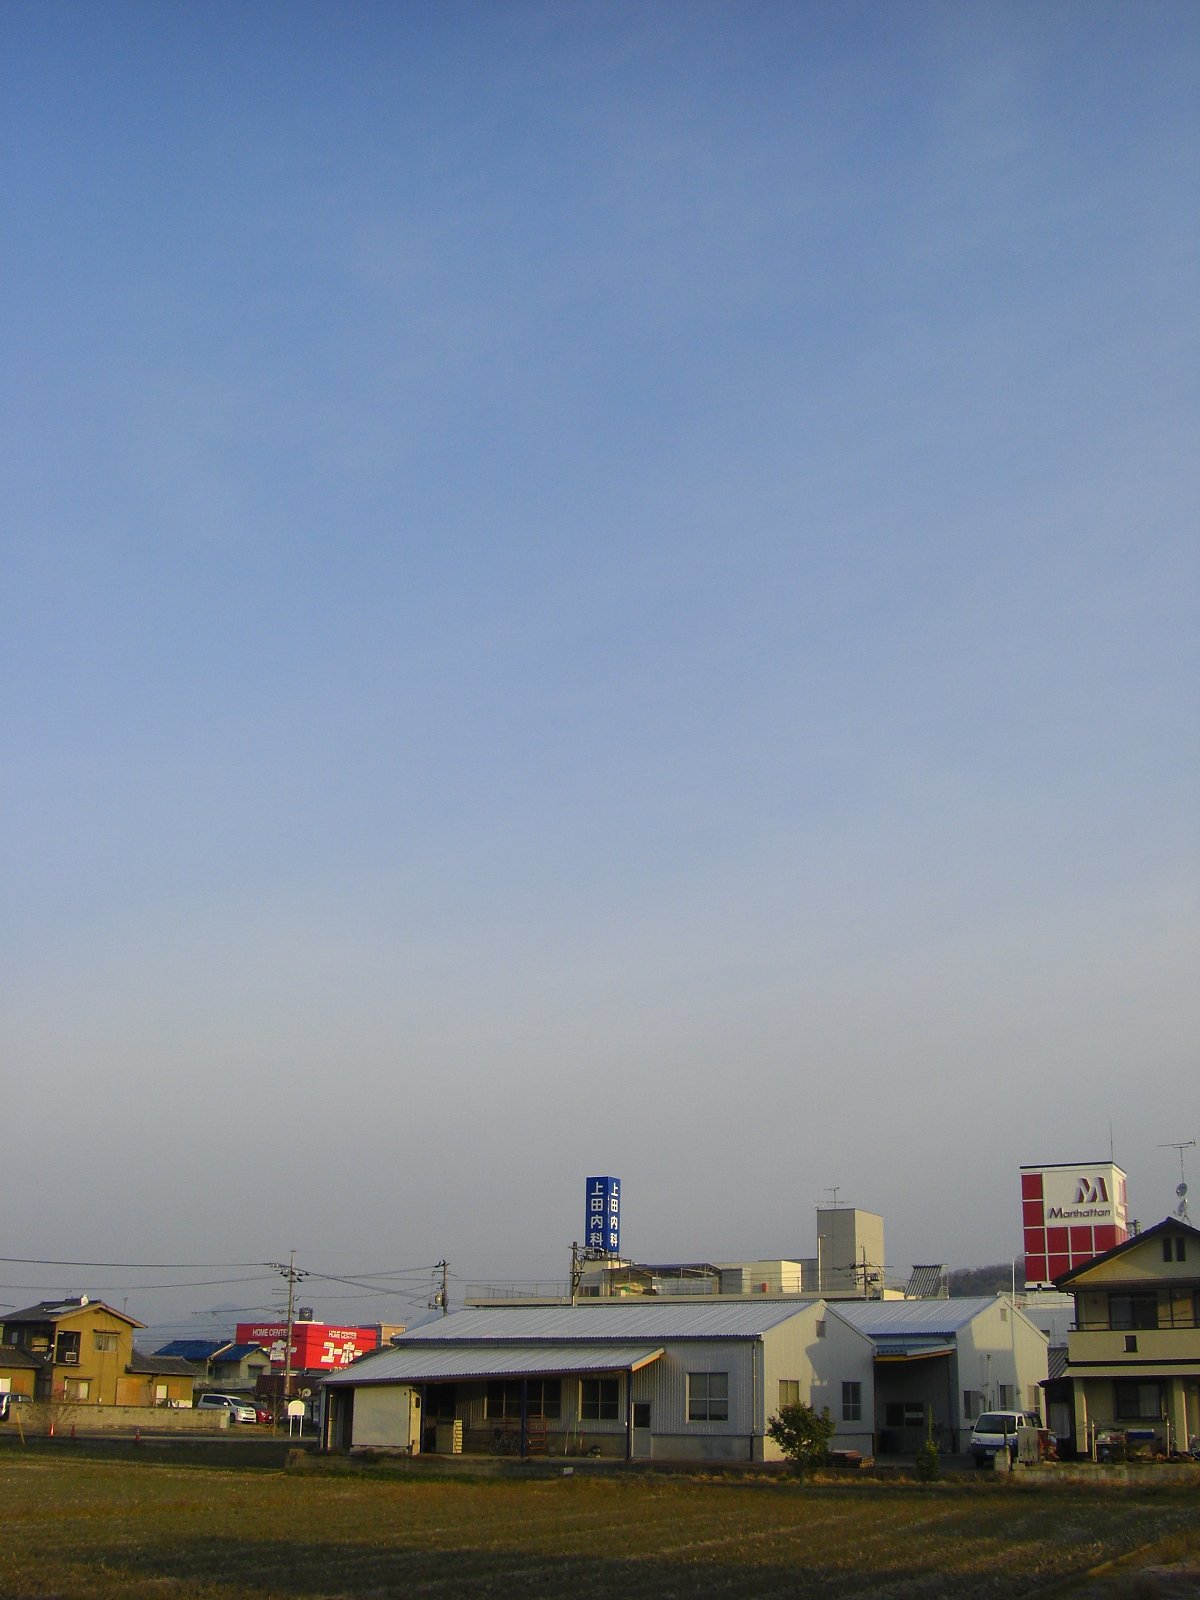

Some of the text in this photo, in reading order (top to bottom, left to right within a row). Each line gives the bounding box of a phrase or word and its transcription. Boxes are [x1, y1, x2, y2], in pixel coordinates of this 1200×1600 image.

[590, 1181, 603, 1246] 上田内科
[610, 1182, 619, 1247] 上田内科
[1049, 1207, 1111, 1219] Manhattan
[252, 1328, 288, 1337] HOME CENTE
[328, 1330, 357, 1339] HOME CENTER
